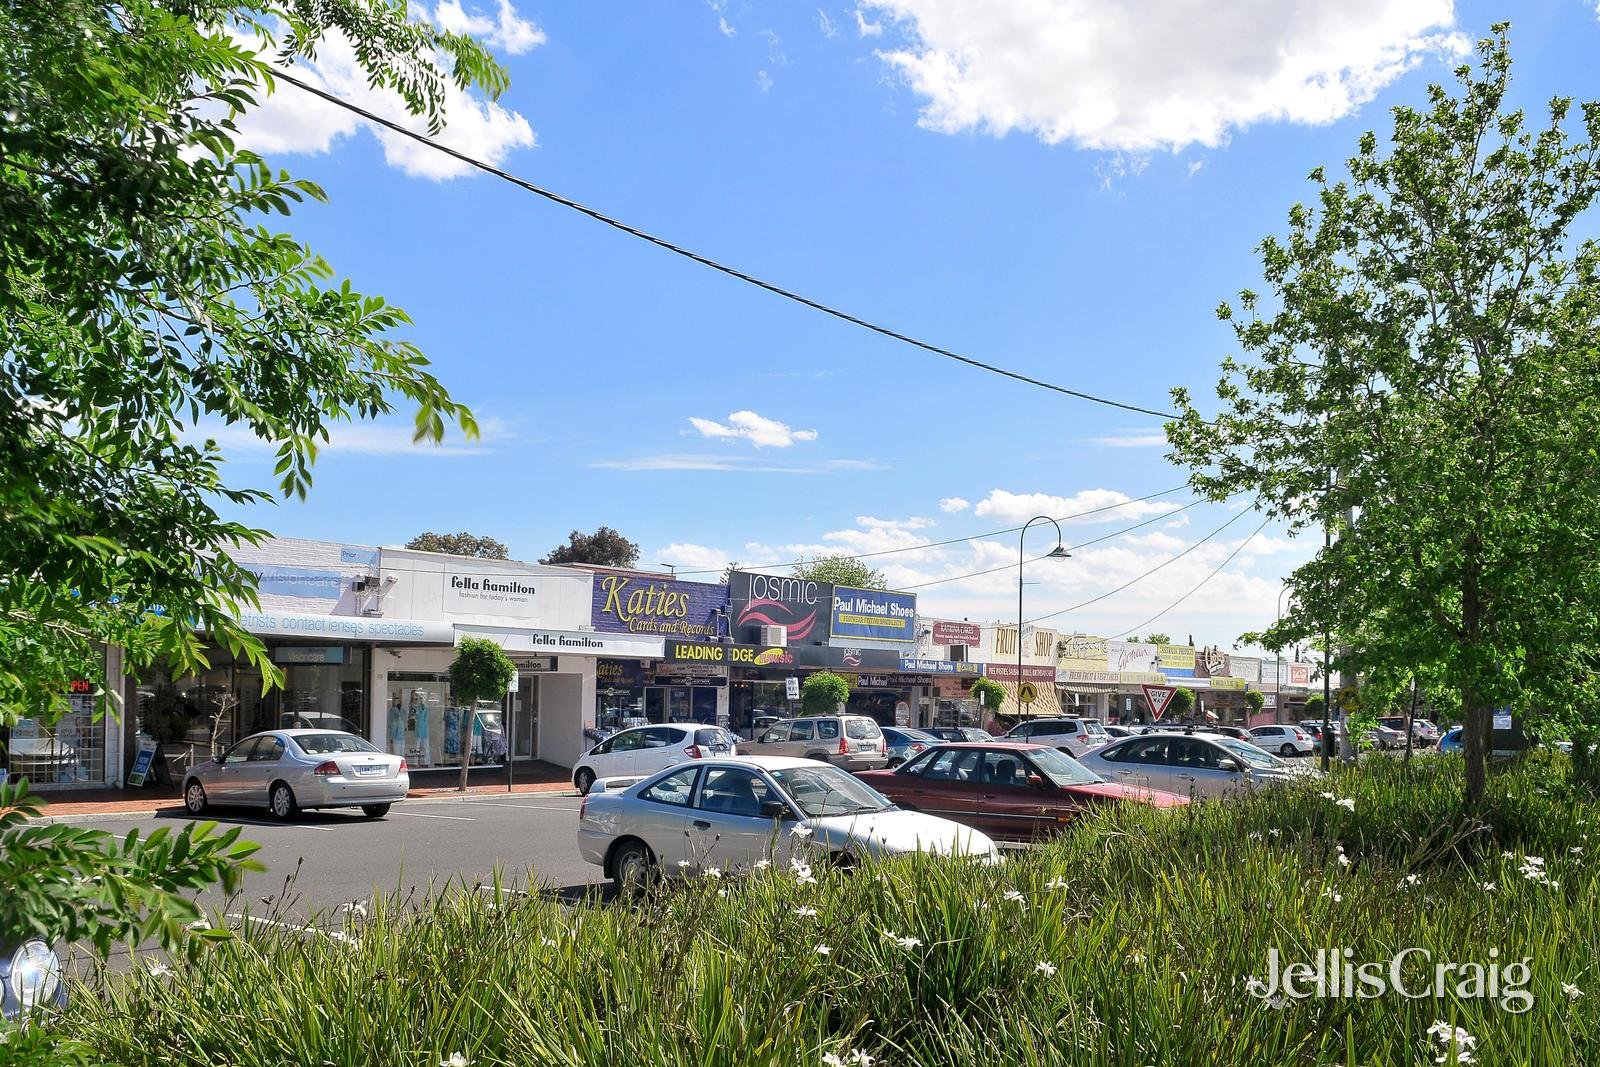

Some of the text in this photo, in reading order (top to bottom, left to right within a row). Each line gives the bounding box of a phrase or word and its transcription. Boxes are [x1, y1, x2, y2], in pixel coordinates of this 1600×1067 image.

[342, 550, 357, 559] Prior
[451, 575, 536, 595] fella hamilton
[459, 592, 479, 600] fashion
[489, 592, 508, 602] today's
[601, 575, 690, 622] Katies
[834, 596, 914, 618] Paul Michael Shoes
[241, 614, 424, 638] etrists contact lenses spectacles
[629, 617, 714, 636] Cards and Records
[533, 634, 603, 648] fella hamilton
[996, 628, 1018, 655] FRUIT
[1035, 631, 1053, 657] SHOP
[675, 645, 722, 661] LEADING
[514, 659, 542, 669] amilton
[904, 661, 916, 669] Paul
[917, 661, 937, 670] Michael
[939, 662, 953, 671] Shoes
[71, 680, 90, 692] PEN
[858, 676, 869, 686] Paul
